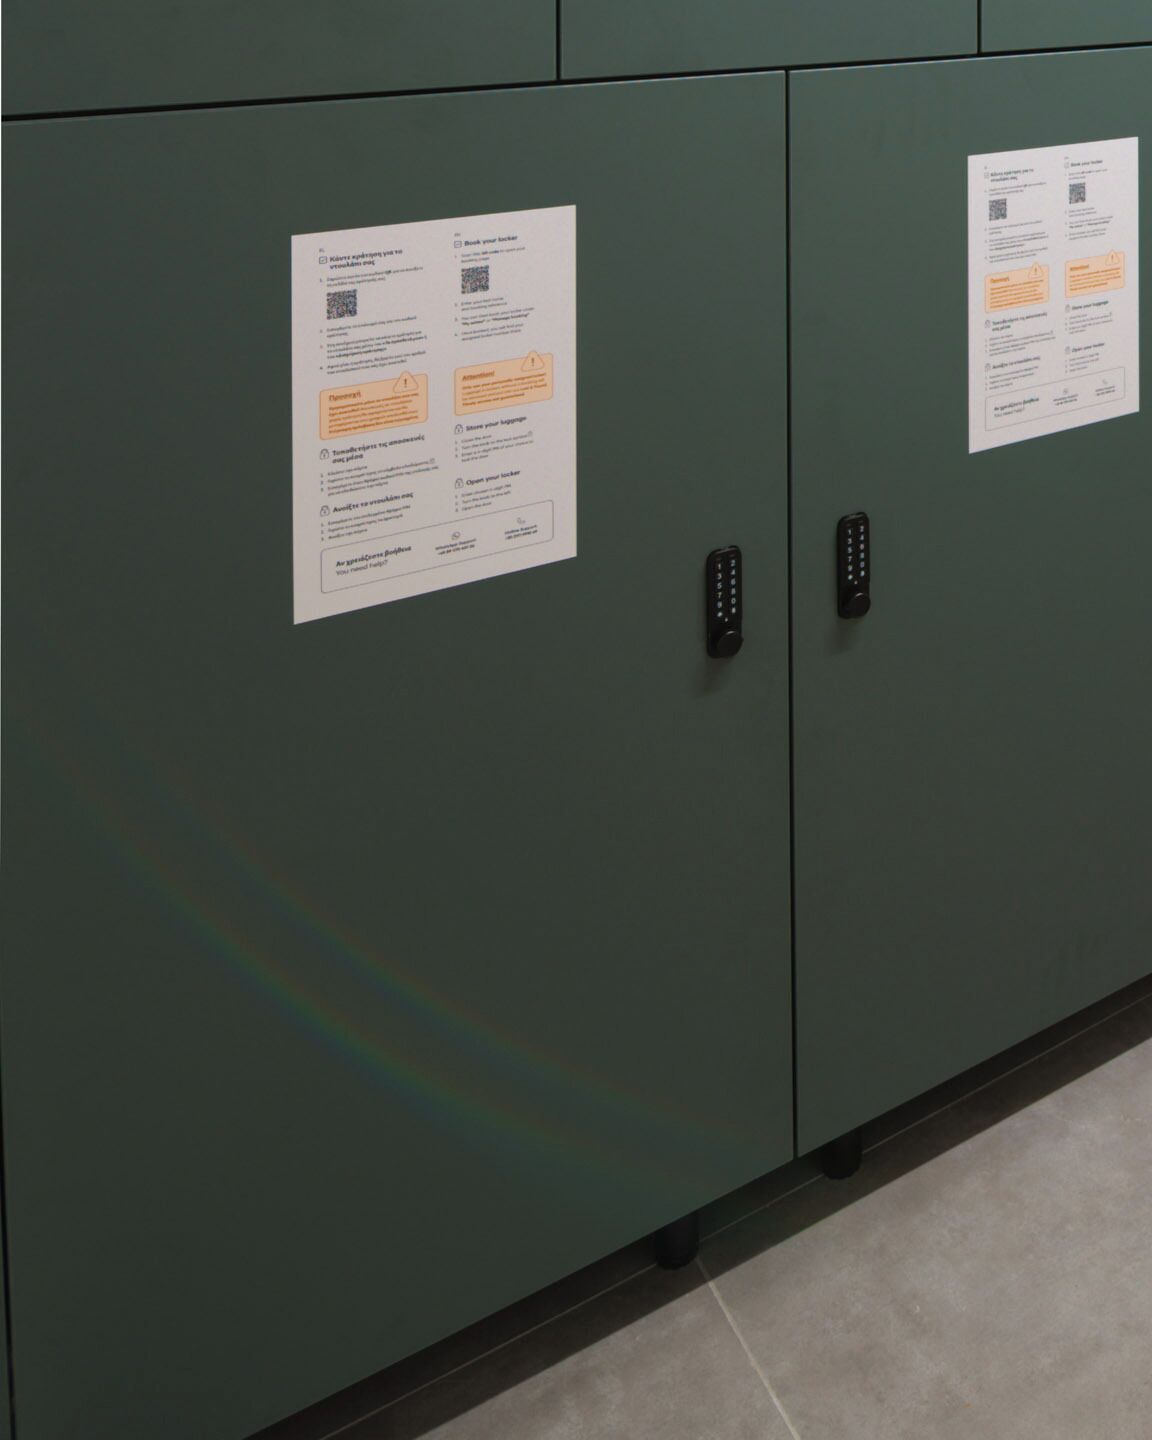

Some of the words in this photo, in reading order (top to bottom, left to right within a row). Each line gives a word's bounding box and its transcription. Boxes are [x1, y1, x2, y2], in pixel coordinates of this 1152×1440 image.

[462, 370, 495, 382] Attention!
[466, 423, 483, 432] Store
[500, 415, 527, 427] luggage
[466, 477, 484, 487] Open
[486, 475, 500, 483] your
[501, 470, 520, 479] locker
[350, 564, 368, 573] need
[370, 559, 388, 570] help?
